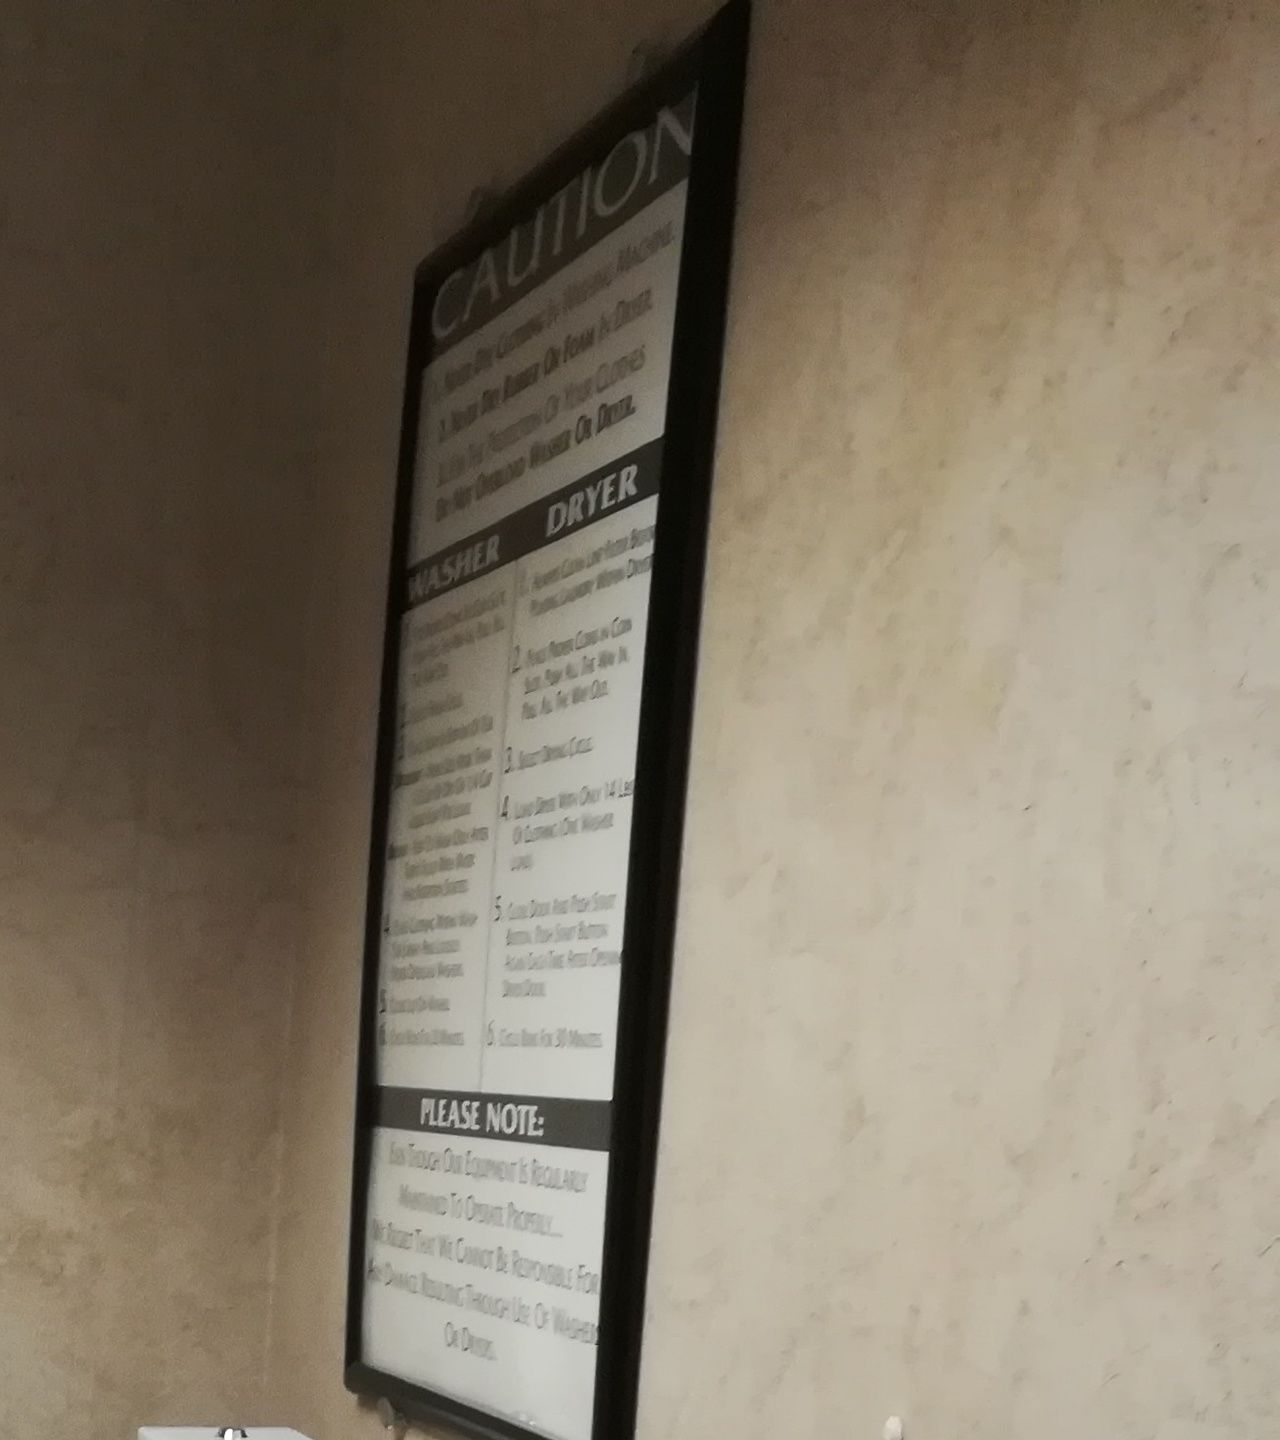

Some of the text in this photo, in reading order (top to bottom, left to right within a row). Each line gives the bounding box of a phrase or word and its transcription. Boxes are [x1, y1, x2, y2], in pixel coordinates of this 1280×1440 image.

[432, 105, 692, 339] CAUTION
[545, 463, 639, 538] DRYER
[409, 534, 500, 602] WASHER
[420, 1097, 545, 1137] PLEASE NOTE:
